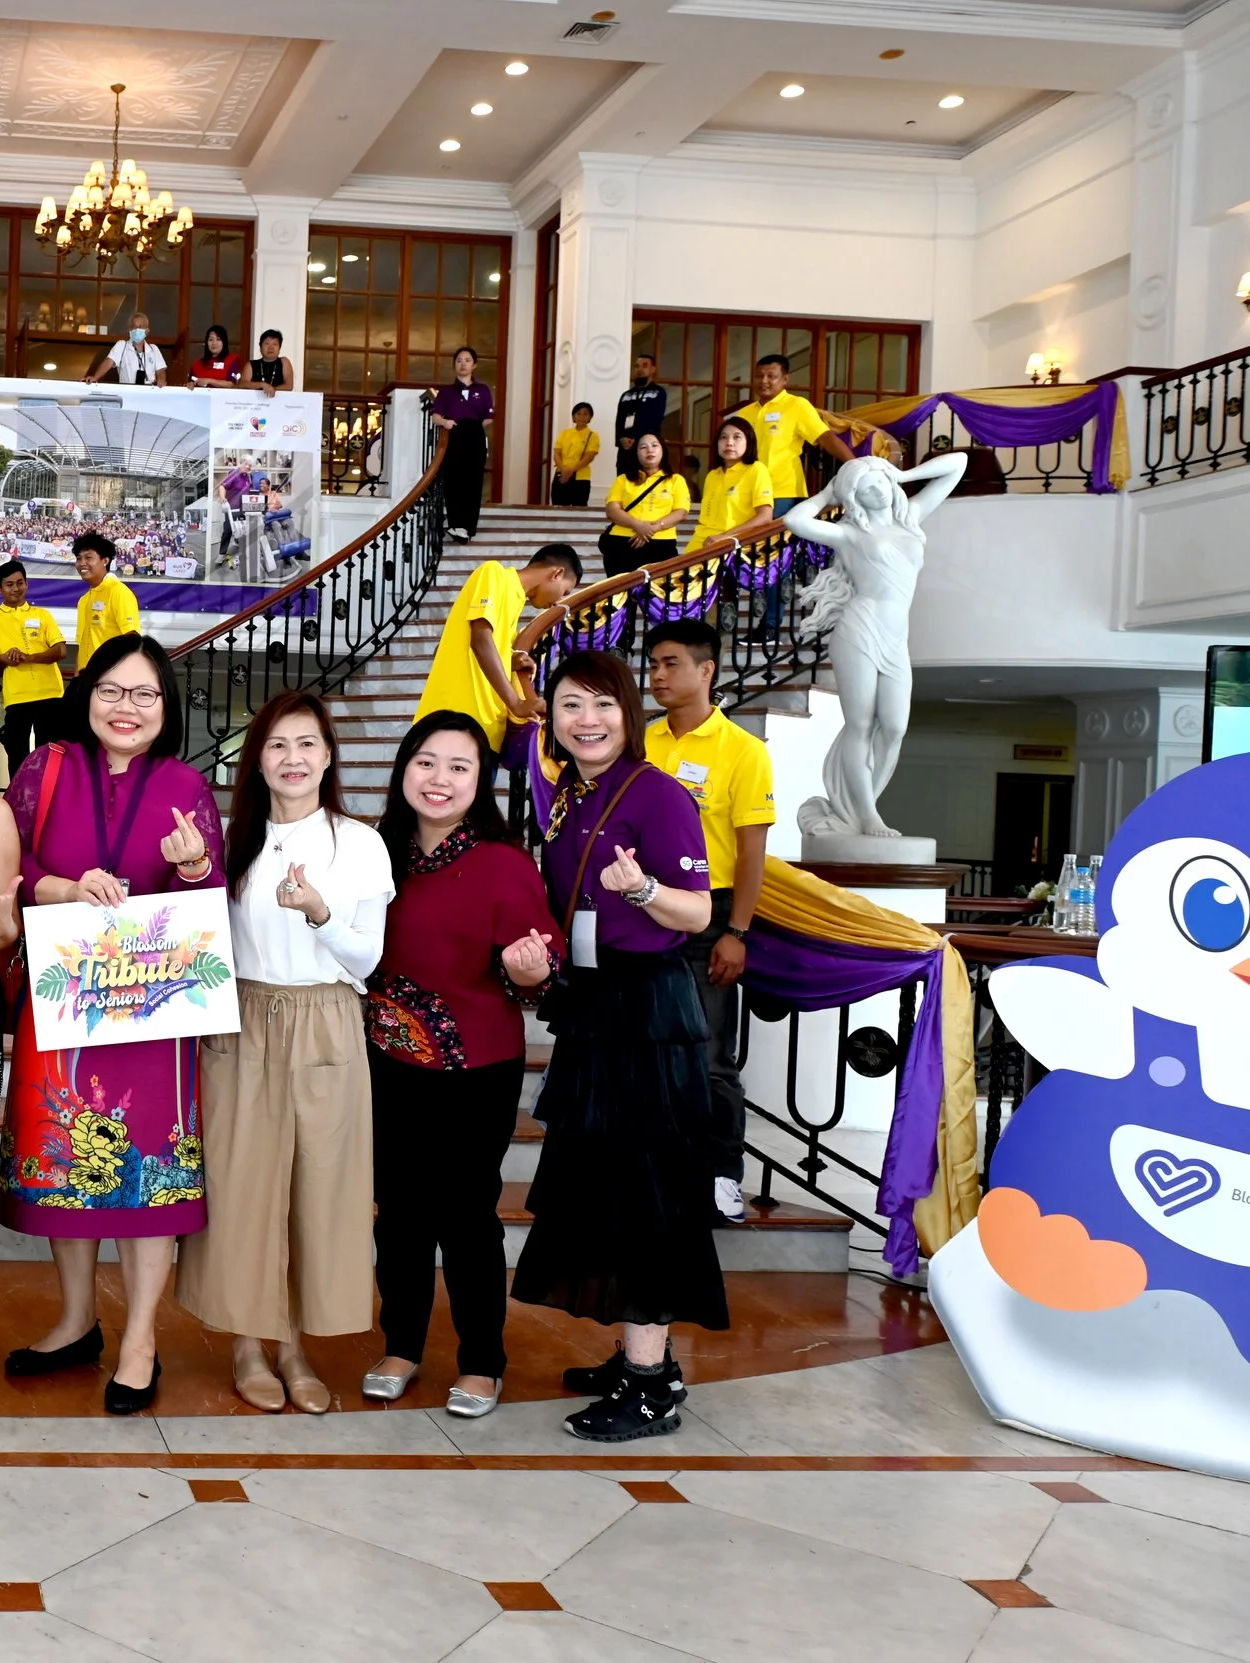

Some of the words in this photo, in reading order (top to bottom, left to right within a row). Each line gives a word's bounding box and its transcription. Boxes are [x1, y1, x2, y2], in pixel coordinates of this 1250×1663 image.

[118, 935, 179, 955] Blossom
[68, 952, 186, 991] Tribute
[76, 995, 90, 1011] to
[95, 990, 146, 1009] Seniors
[148, 990, 164, 1007] Social
[163, 981, 188, 997] Cohesion
[1231, 1188, 1250, 1205] Blo
